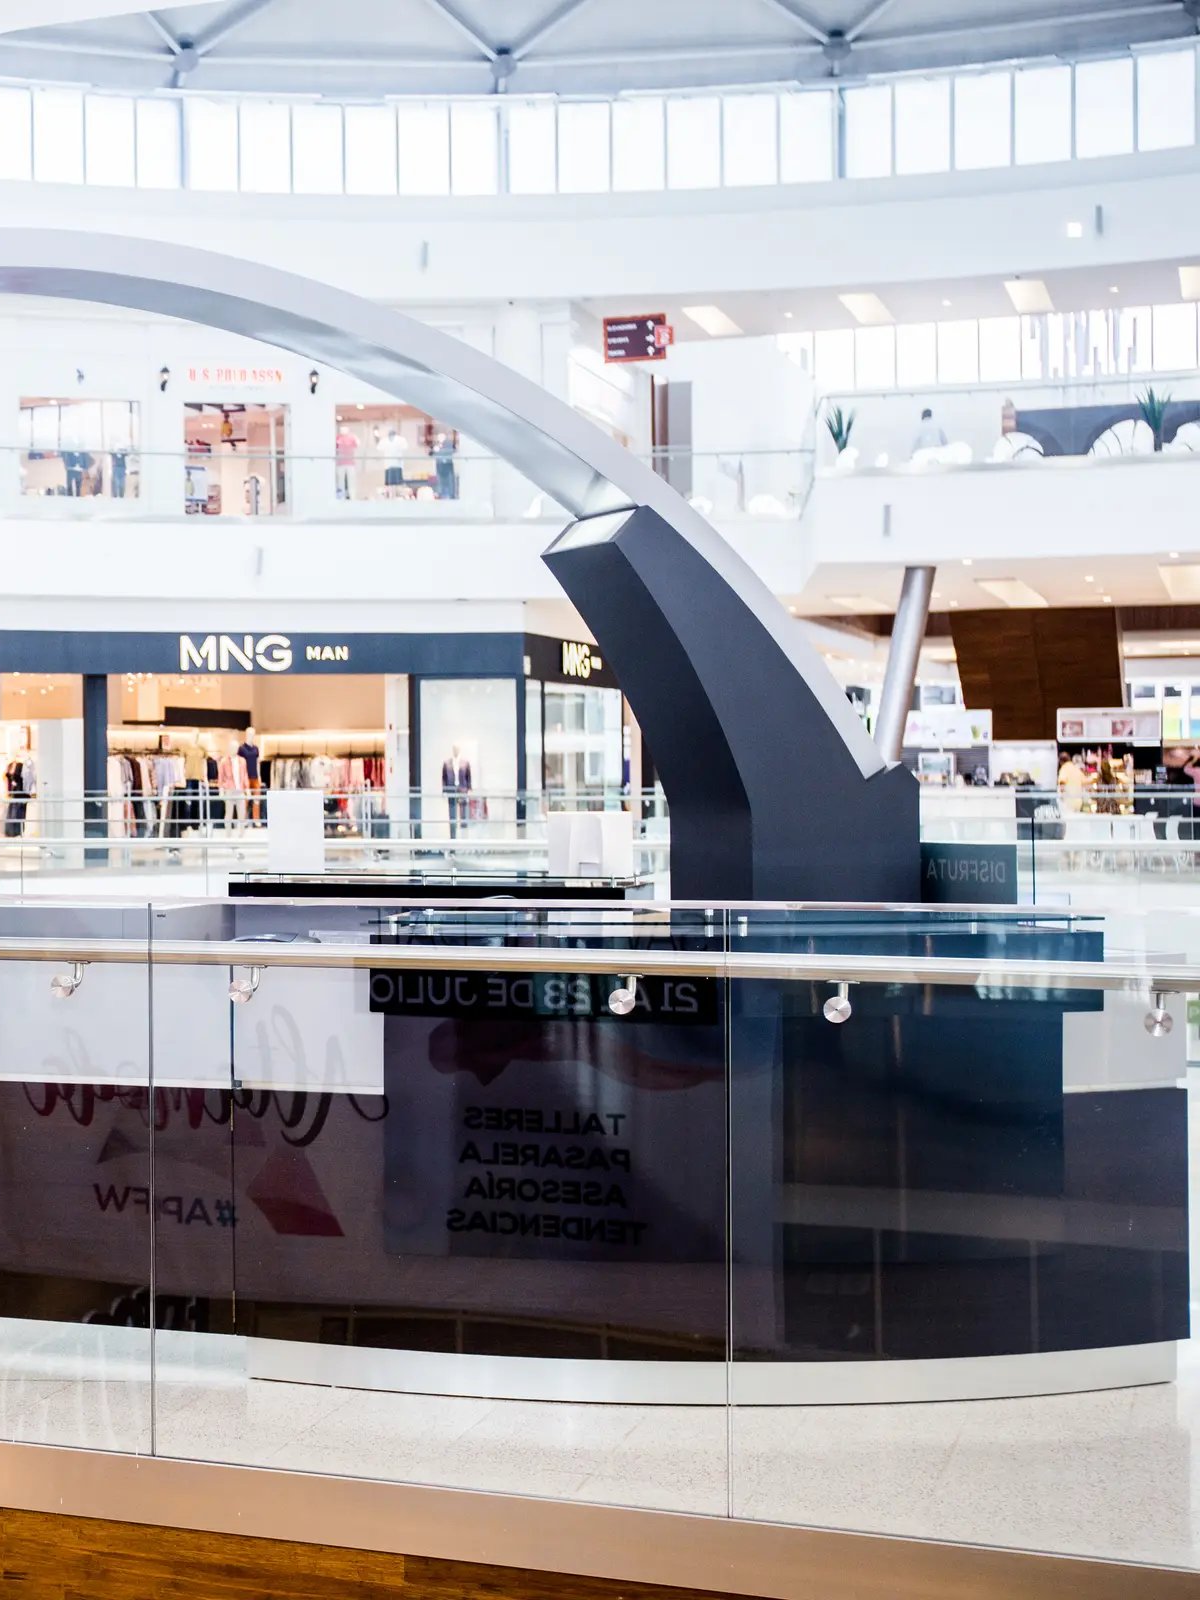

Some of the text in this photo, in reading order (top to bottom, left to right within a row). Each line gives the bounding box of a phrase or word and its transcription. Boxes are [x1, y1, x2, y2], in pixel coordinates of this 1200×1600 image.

[179, 634, 349, 672] MNG MAN
[562, 641, 591, 679] MNG
